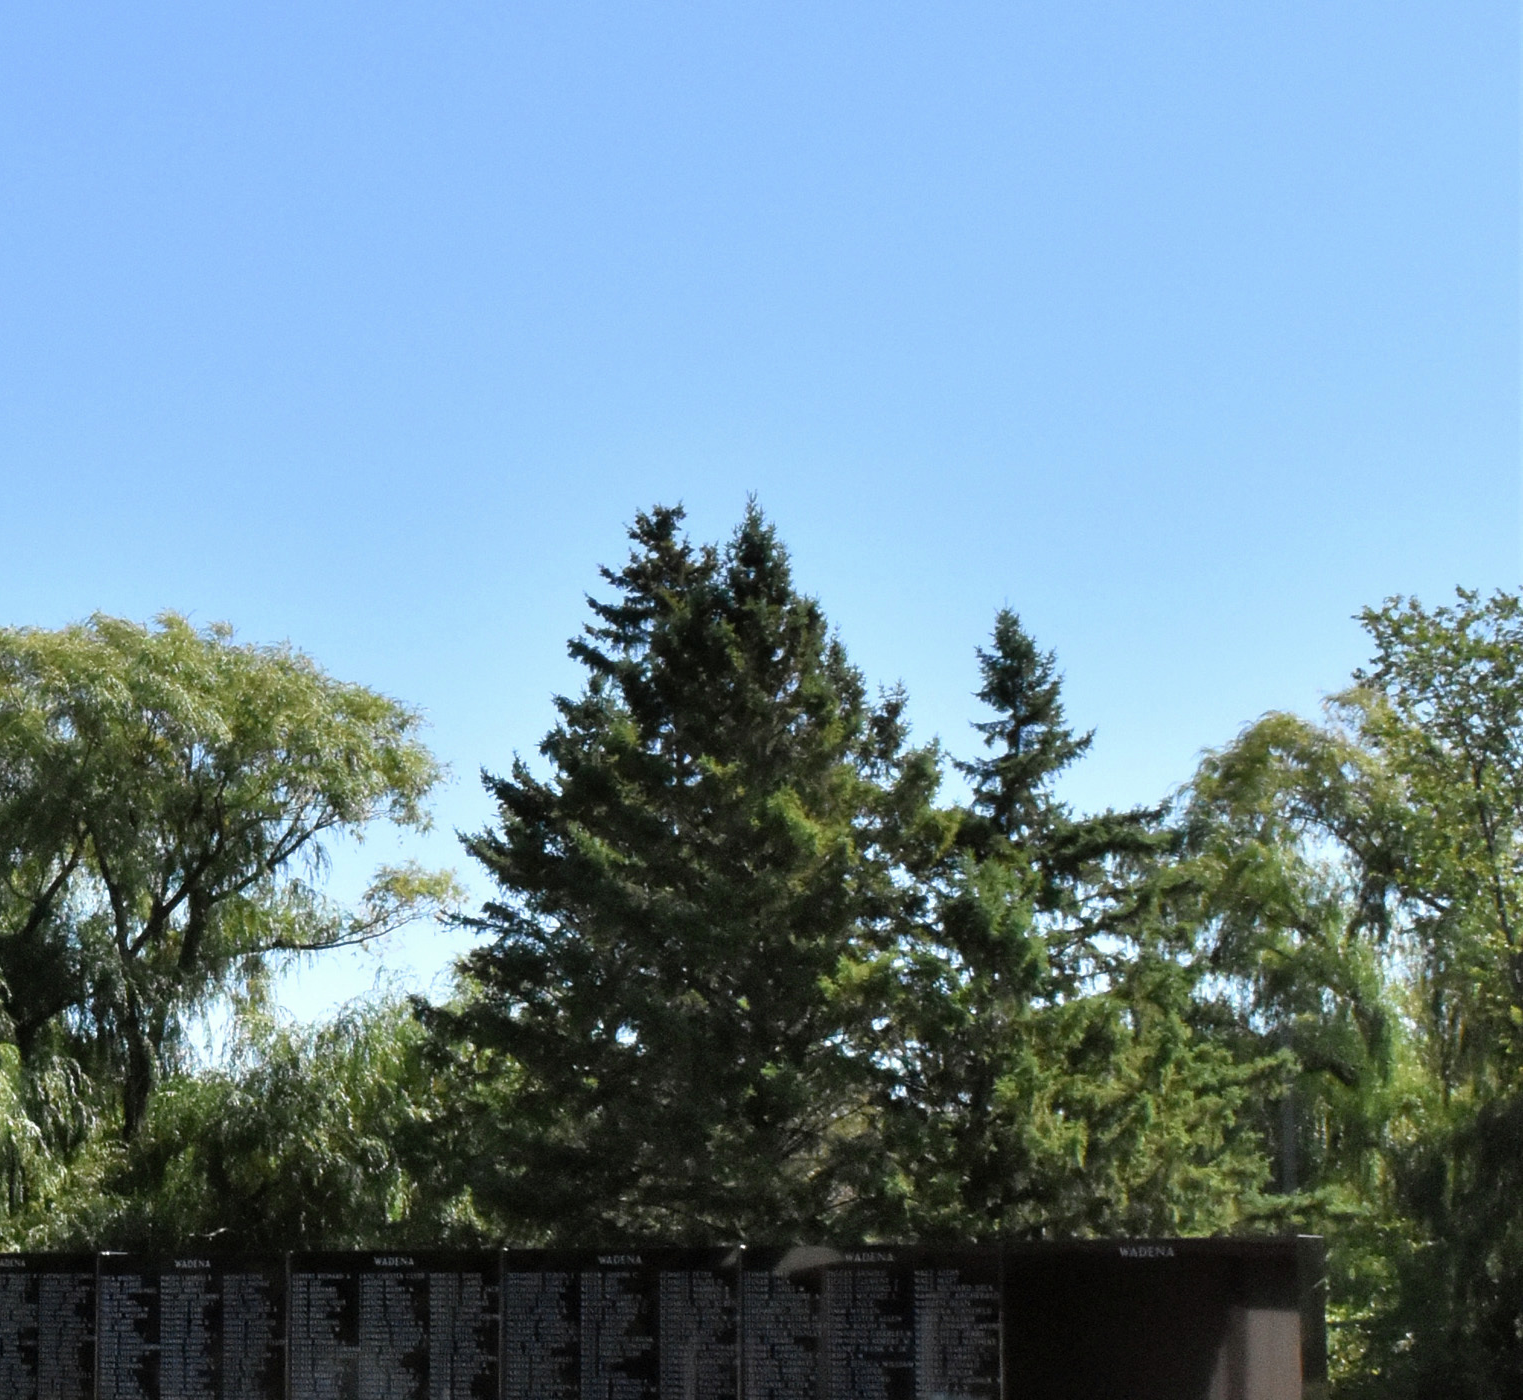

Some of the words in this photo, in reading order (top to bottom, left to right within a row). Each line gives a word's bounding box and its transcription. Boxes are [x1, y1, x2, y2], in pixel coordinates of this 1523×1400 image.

[845, 1252, 895, 1262] WADENA
[1118, 1246, 1175, 1258] WADENA
[173, 1259, 212, 1268] WADENA
[373, 1256, 415, 1266] WADENA
[596, 1255, 643, 1265] WADENA
